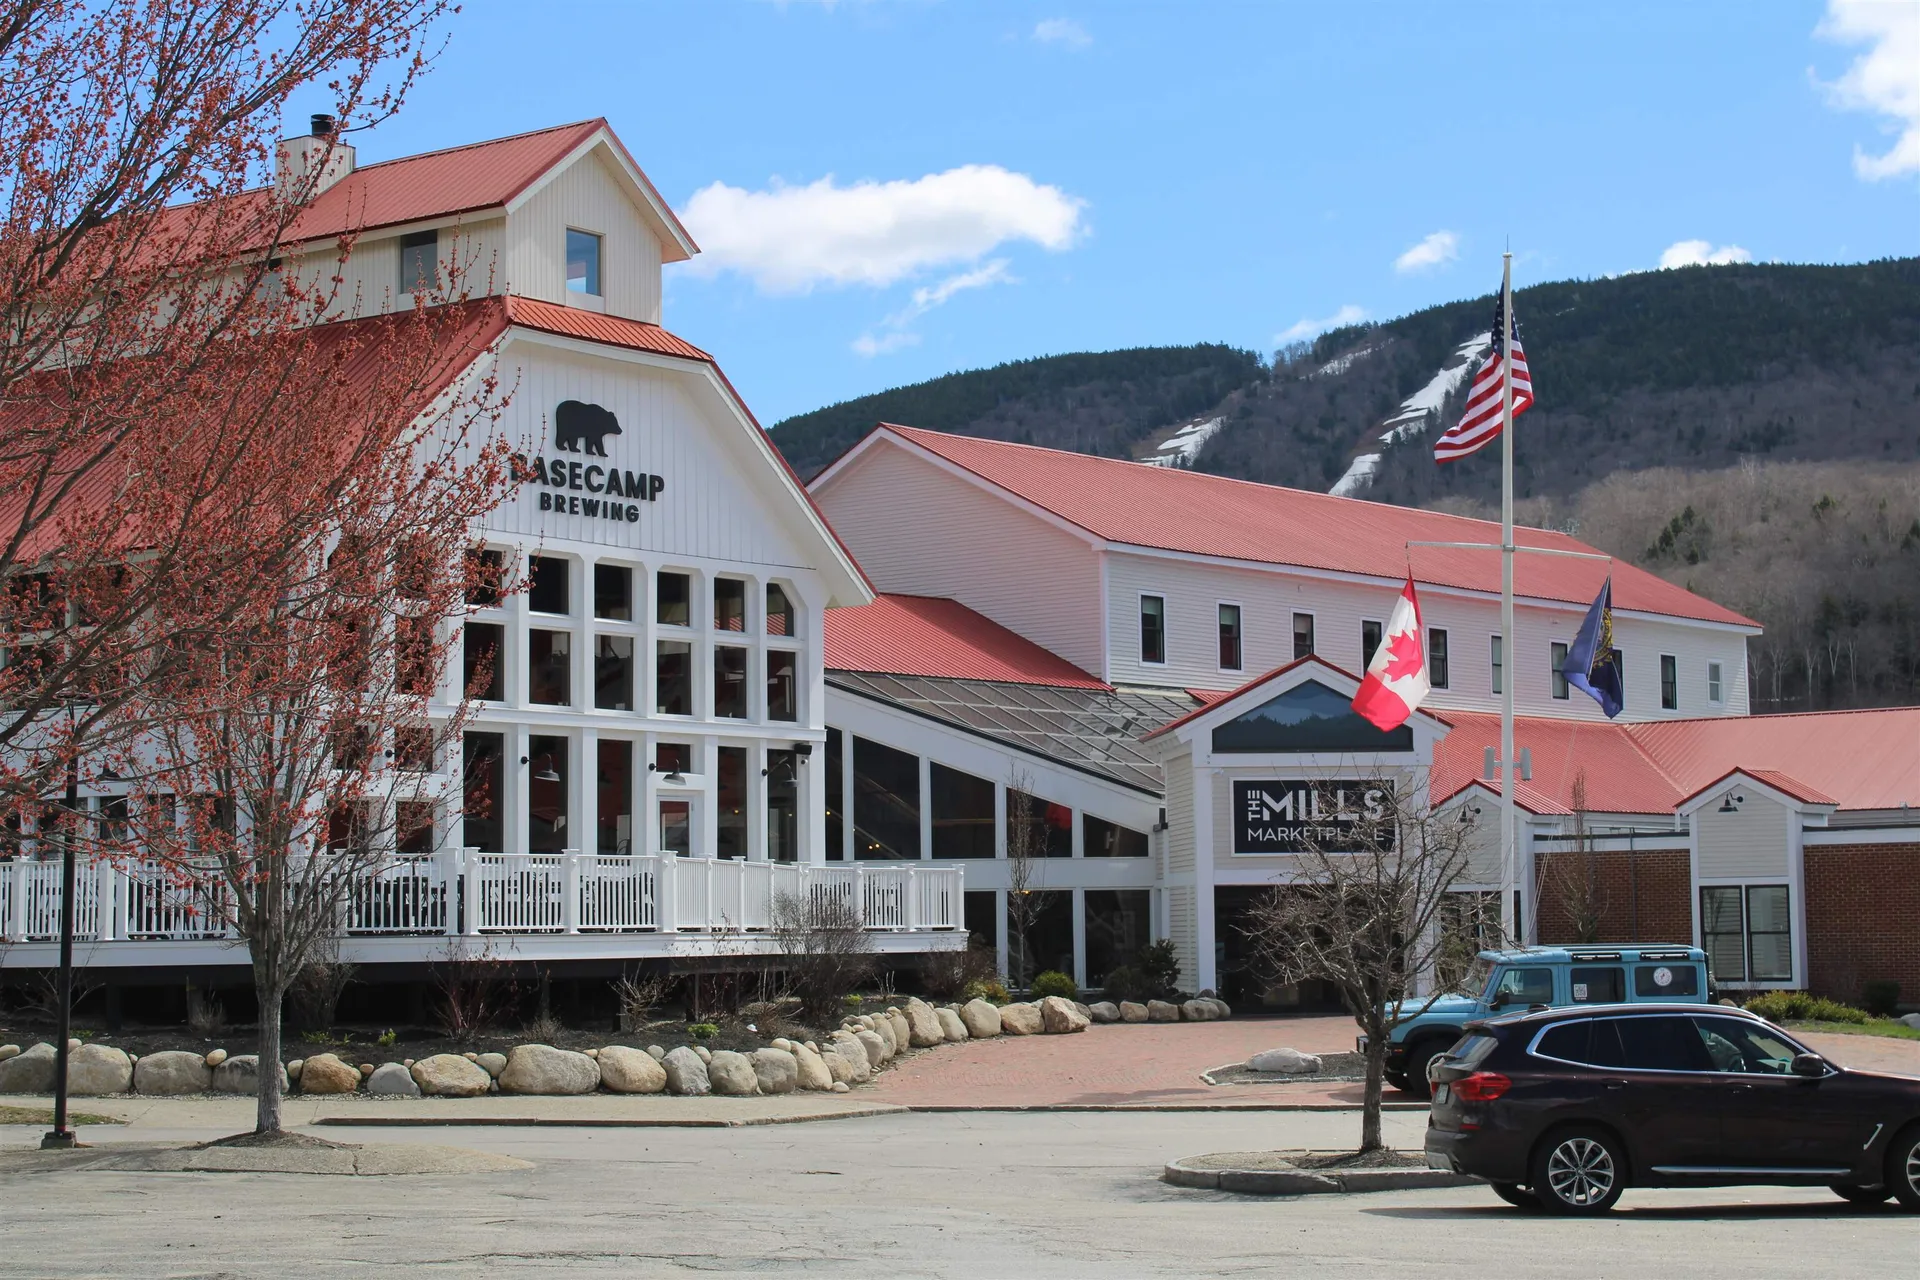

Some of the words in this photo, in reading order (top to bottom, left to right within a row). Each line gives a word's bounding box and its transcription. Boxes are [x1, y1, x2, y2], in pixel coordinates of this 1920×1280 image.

[540, 492, 640, 523] BREWING
[1247, 790, 1260, 821] THE
[1262, 789, 1384, 821] MILLS
[1247, 826, 1385, 842] MARKETPLAE
